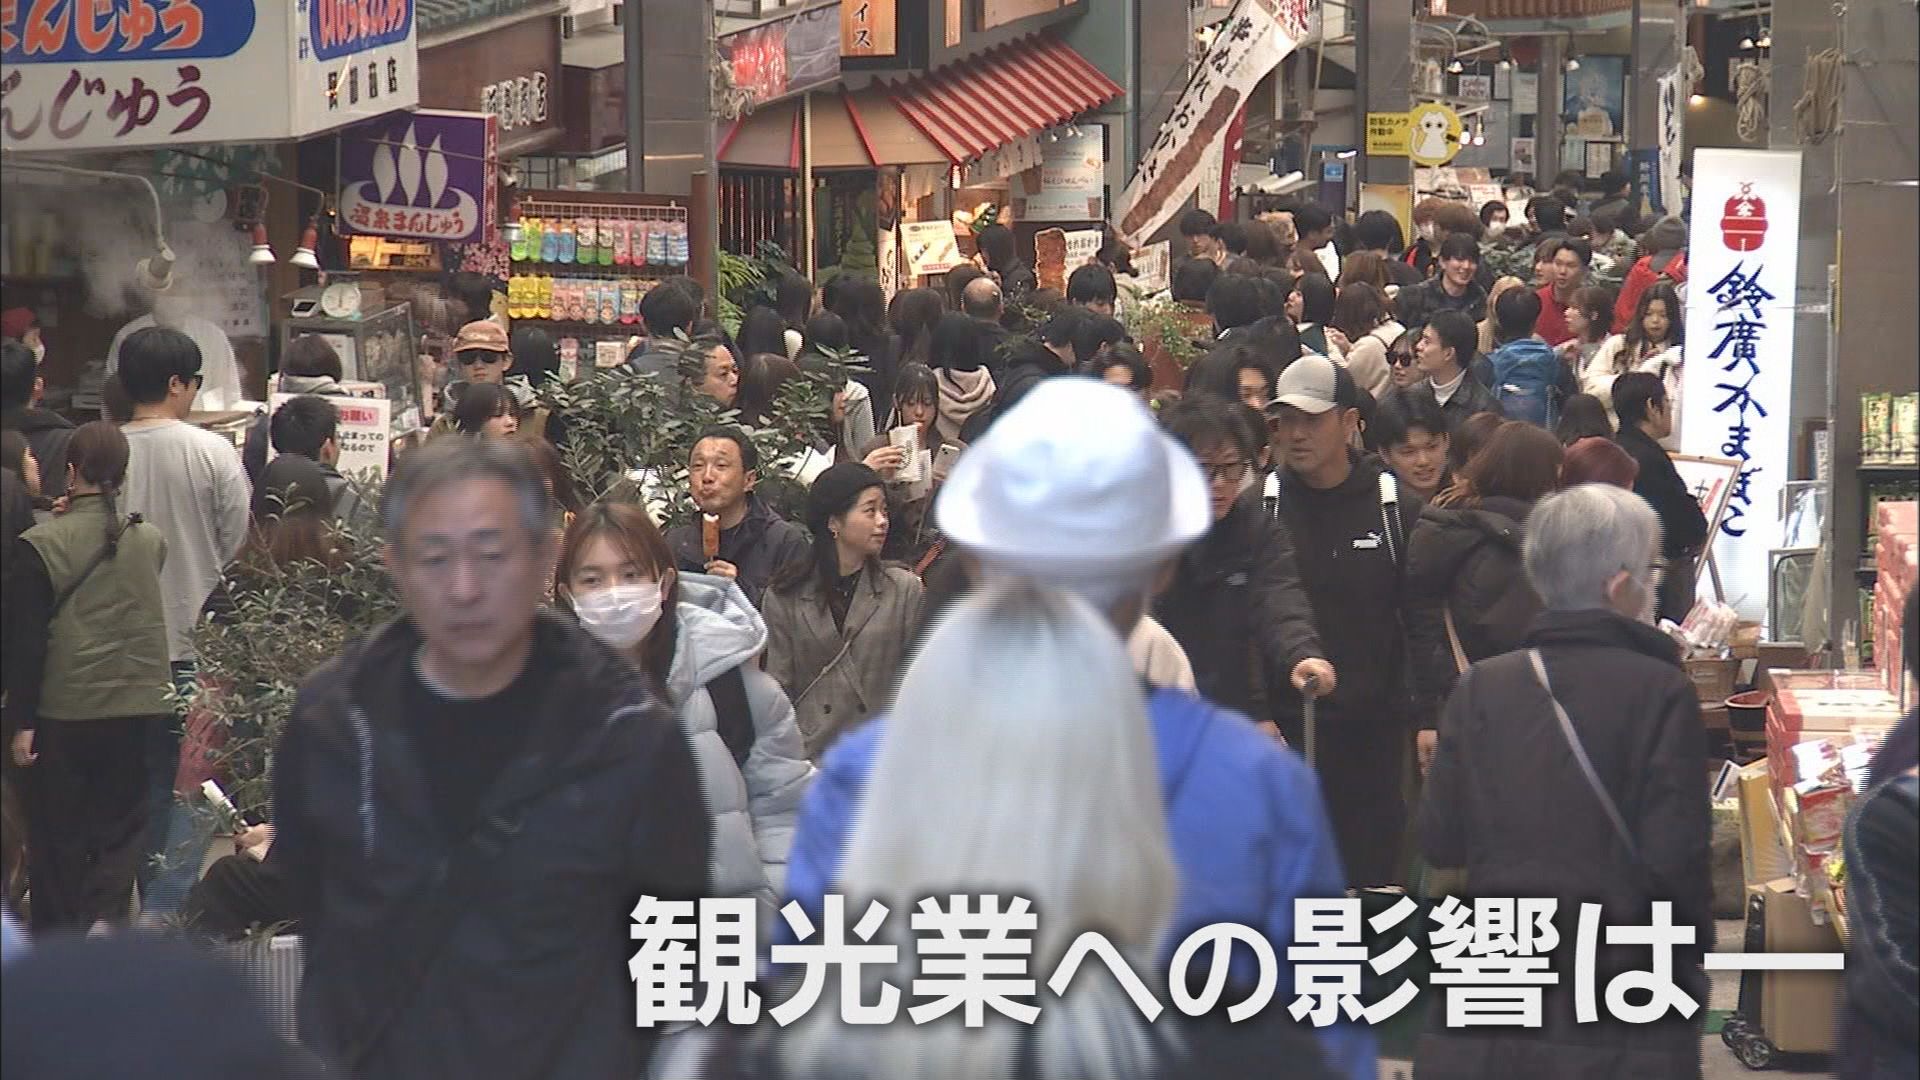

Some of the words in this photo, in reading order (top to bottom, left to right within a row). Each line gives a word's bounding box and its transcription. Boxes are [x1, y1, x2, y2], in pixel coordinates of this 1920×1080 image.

[852, 3, 872, 48] イス
[353, 202, 464, 234] 温泉まんじゅう
[1706, 259, 1776, 537] 鈴廣かまぼこ
